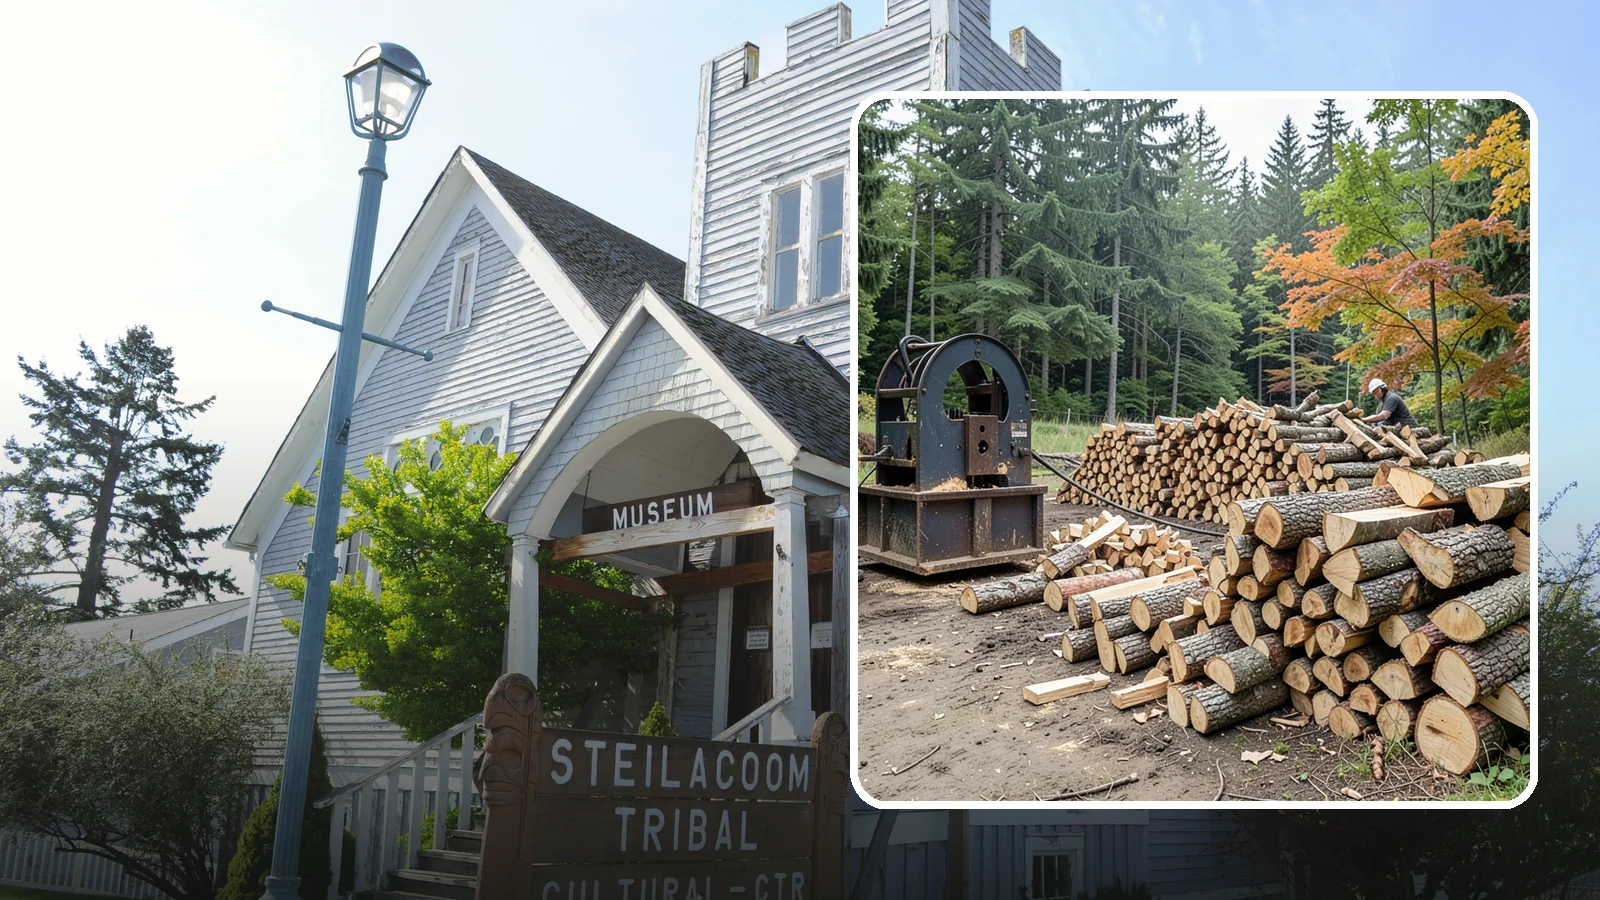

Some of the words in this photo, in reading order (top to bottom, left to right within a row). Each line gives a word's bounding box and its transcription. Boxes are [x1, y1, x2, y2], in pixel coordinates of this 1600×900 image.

[613, 492, 713, 530] MUSEUM
[551, 739, 809, 791] STEILACOOM
[615, 807, 757, 851] TRIBAL
